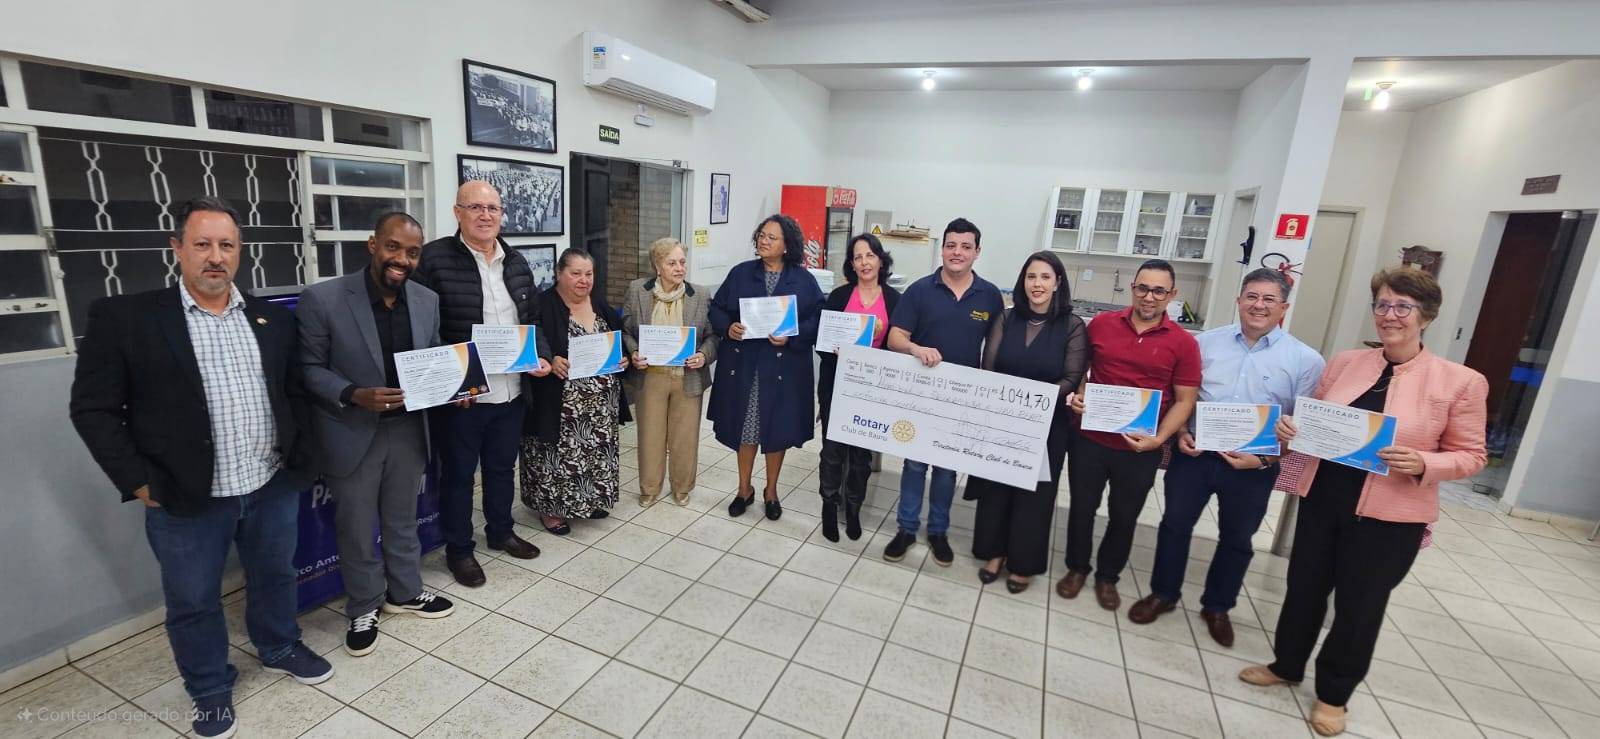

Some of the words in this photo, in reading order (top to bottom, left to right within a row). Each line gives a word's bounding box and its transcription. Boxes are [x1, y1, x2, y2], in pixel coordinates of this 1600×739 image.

[600, 128, 619, 140] SAÍDA
[1203, 406, 1252, 414] CERTIFICADO
[1303, 403, 1360, 420] CERTIFICADO
[841, 424, 857, 434] Club
[858, 429, 867, 437] de
[868, 432, 888, 441] Bauru
[853, 414, 890, 434] Rotary
[985, 454, 1001, 462] Club
[312, 484, 332, 508] PA
